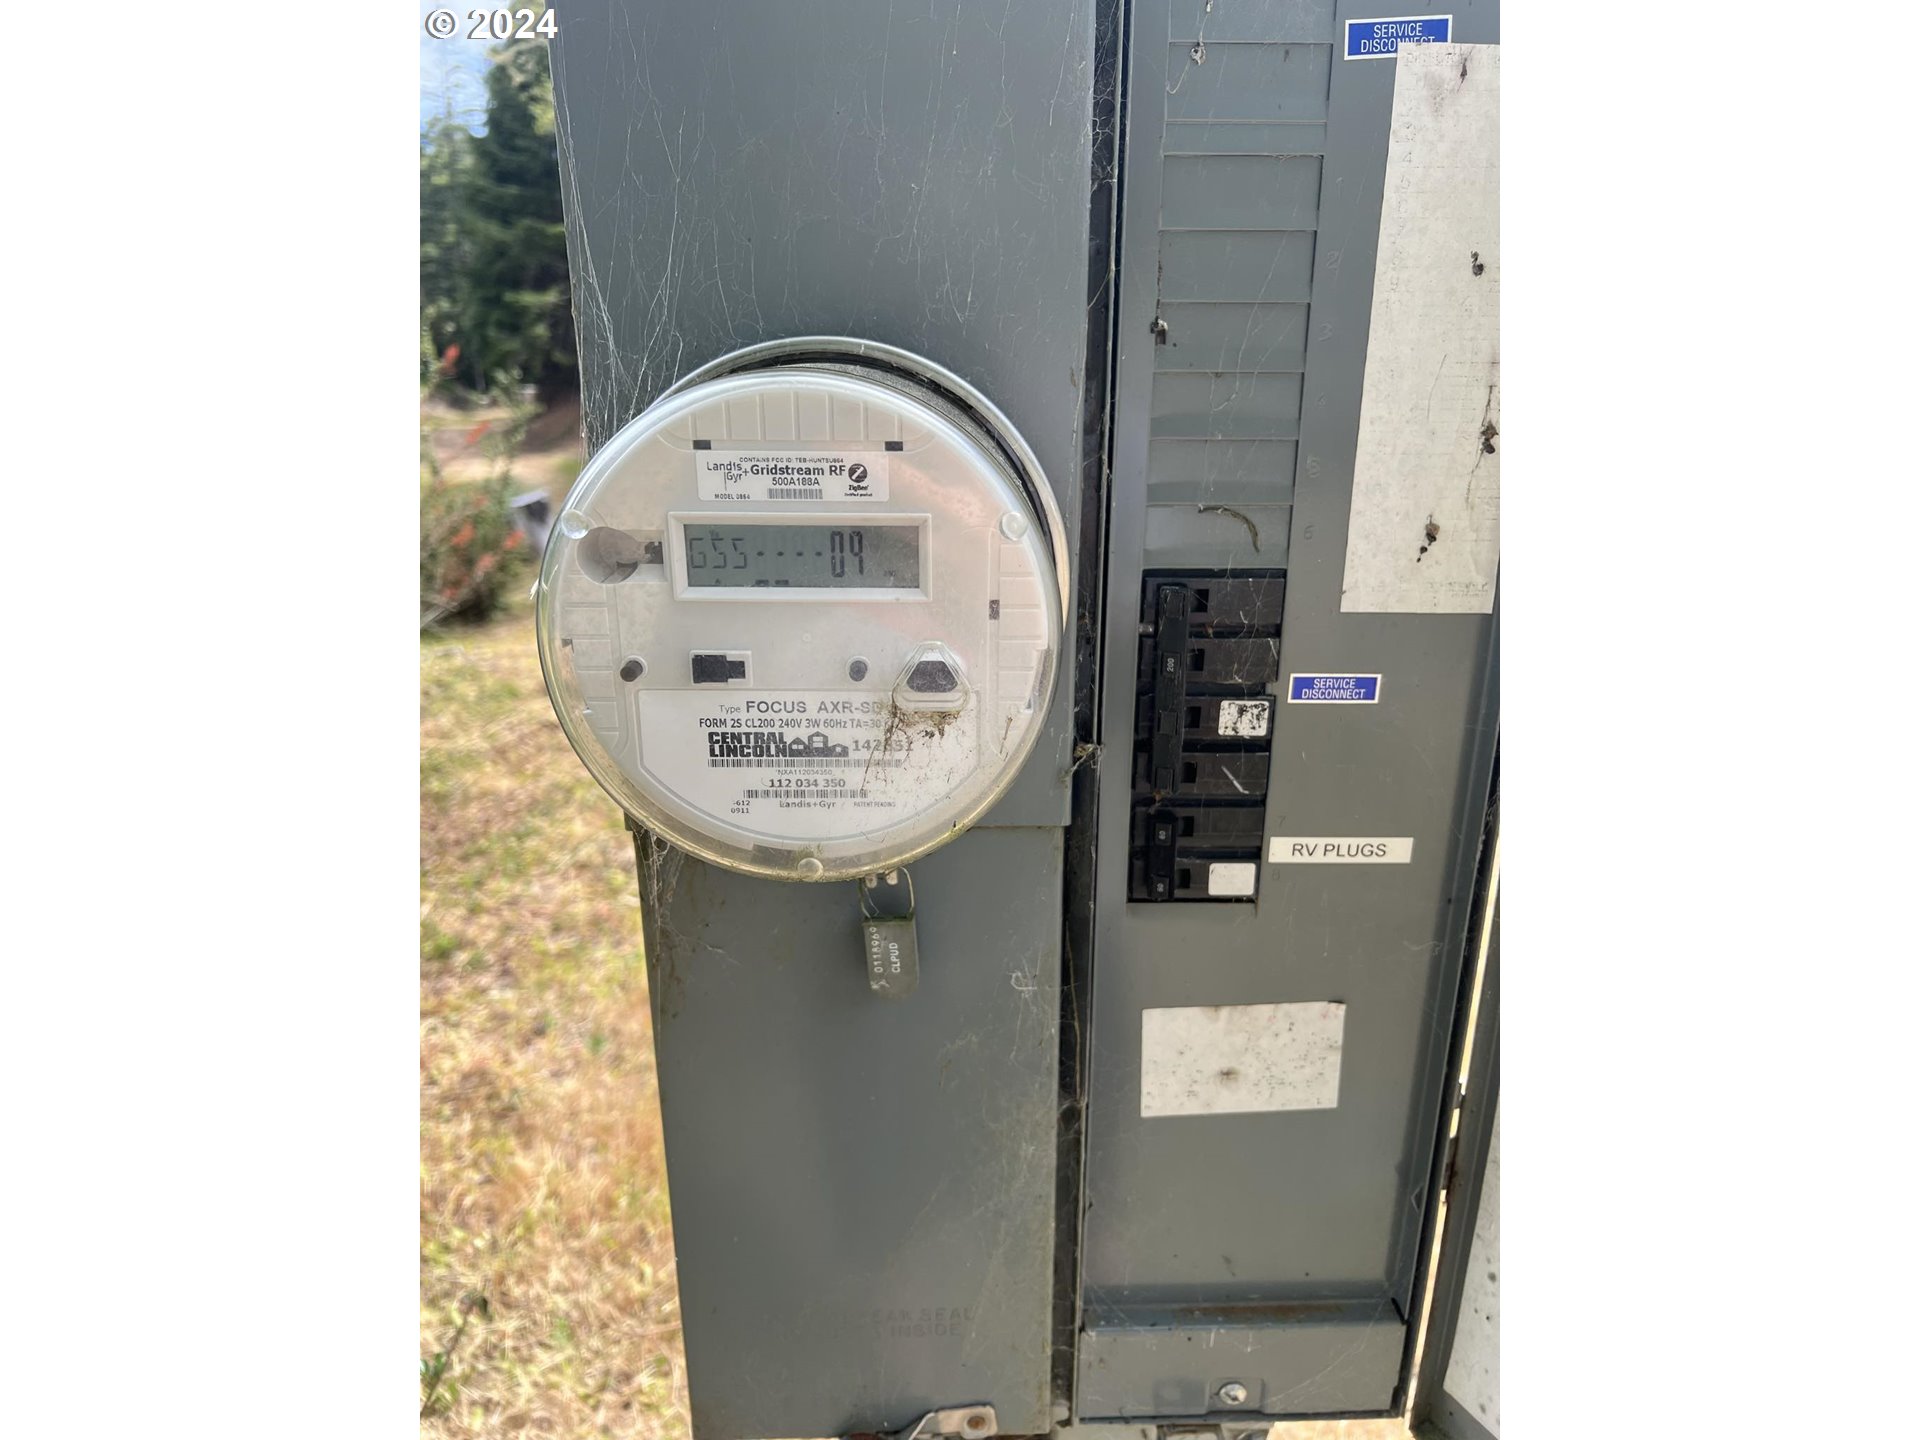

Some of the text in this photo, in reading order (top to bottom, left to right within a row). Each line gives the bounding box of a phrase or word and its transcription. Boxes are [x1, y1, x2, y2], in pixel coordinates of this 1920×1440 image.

[1373, 23, 1423, 38] SERVICE
[1360, 36, 1435, 53] DISCO
[750, 464, 846, 476] Gridstream RF
[1166, 657, 1175, 672] 200
[1313, 678, 1356, 689] SERVICE
[1301, 688, 1366, 700] DISCONNECT
[719, 704, 741, 714] Type
[746, 701, 807, 713] FOCUS
[700, 718, 727, 728] FORM
[730, 718, 742, 728] 2S
[745, 718, 775, 728] CL200
[778, 718, 802, 728] 240V
[805, 718, 820, 728] 3W
[823, 718, 847, 728] 60Hz
[707, 731, 787, 745] CENTRAL
[709, 744, 788, 758] LINCOLN
[769, 779, 846, 788] 112 034 350
[1291, 843, 1387, 857] RV PLUGS
[889, 942, 900, 973] CLPUD
